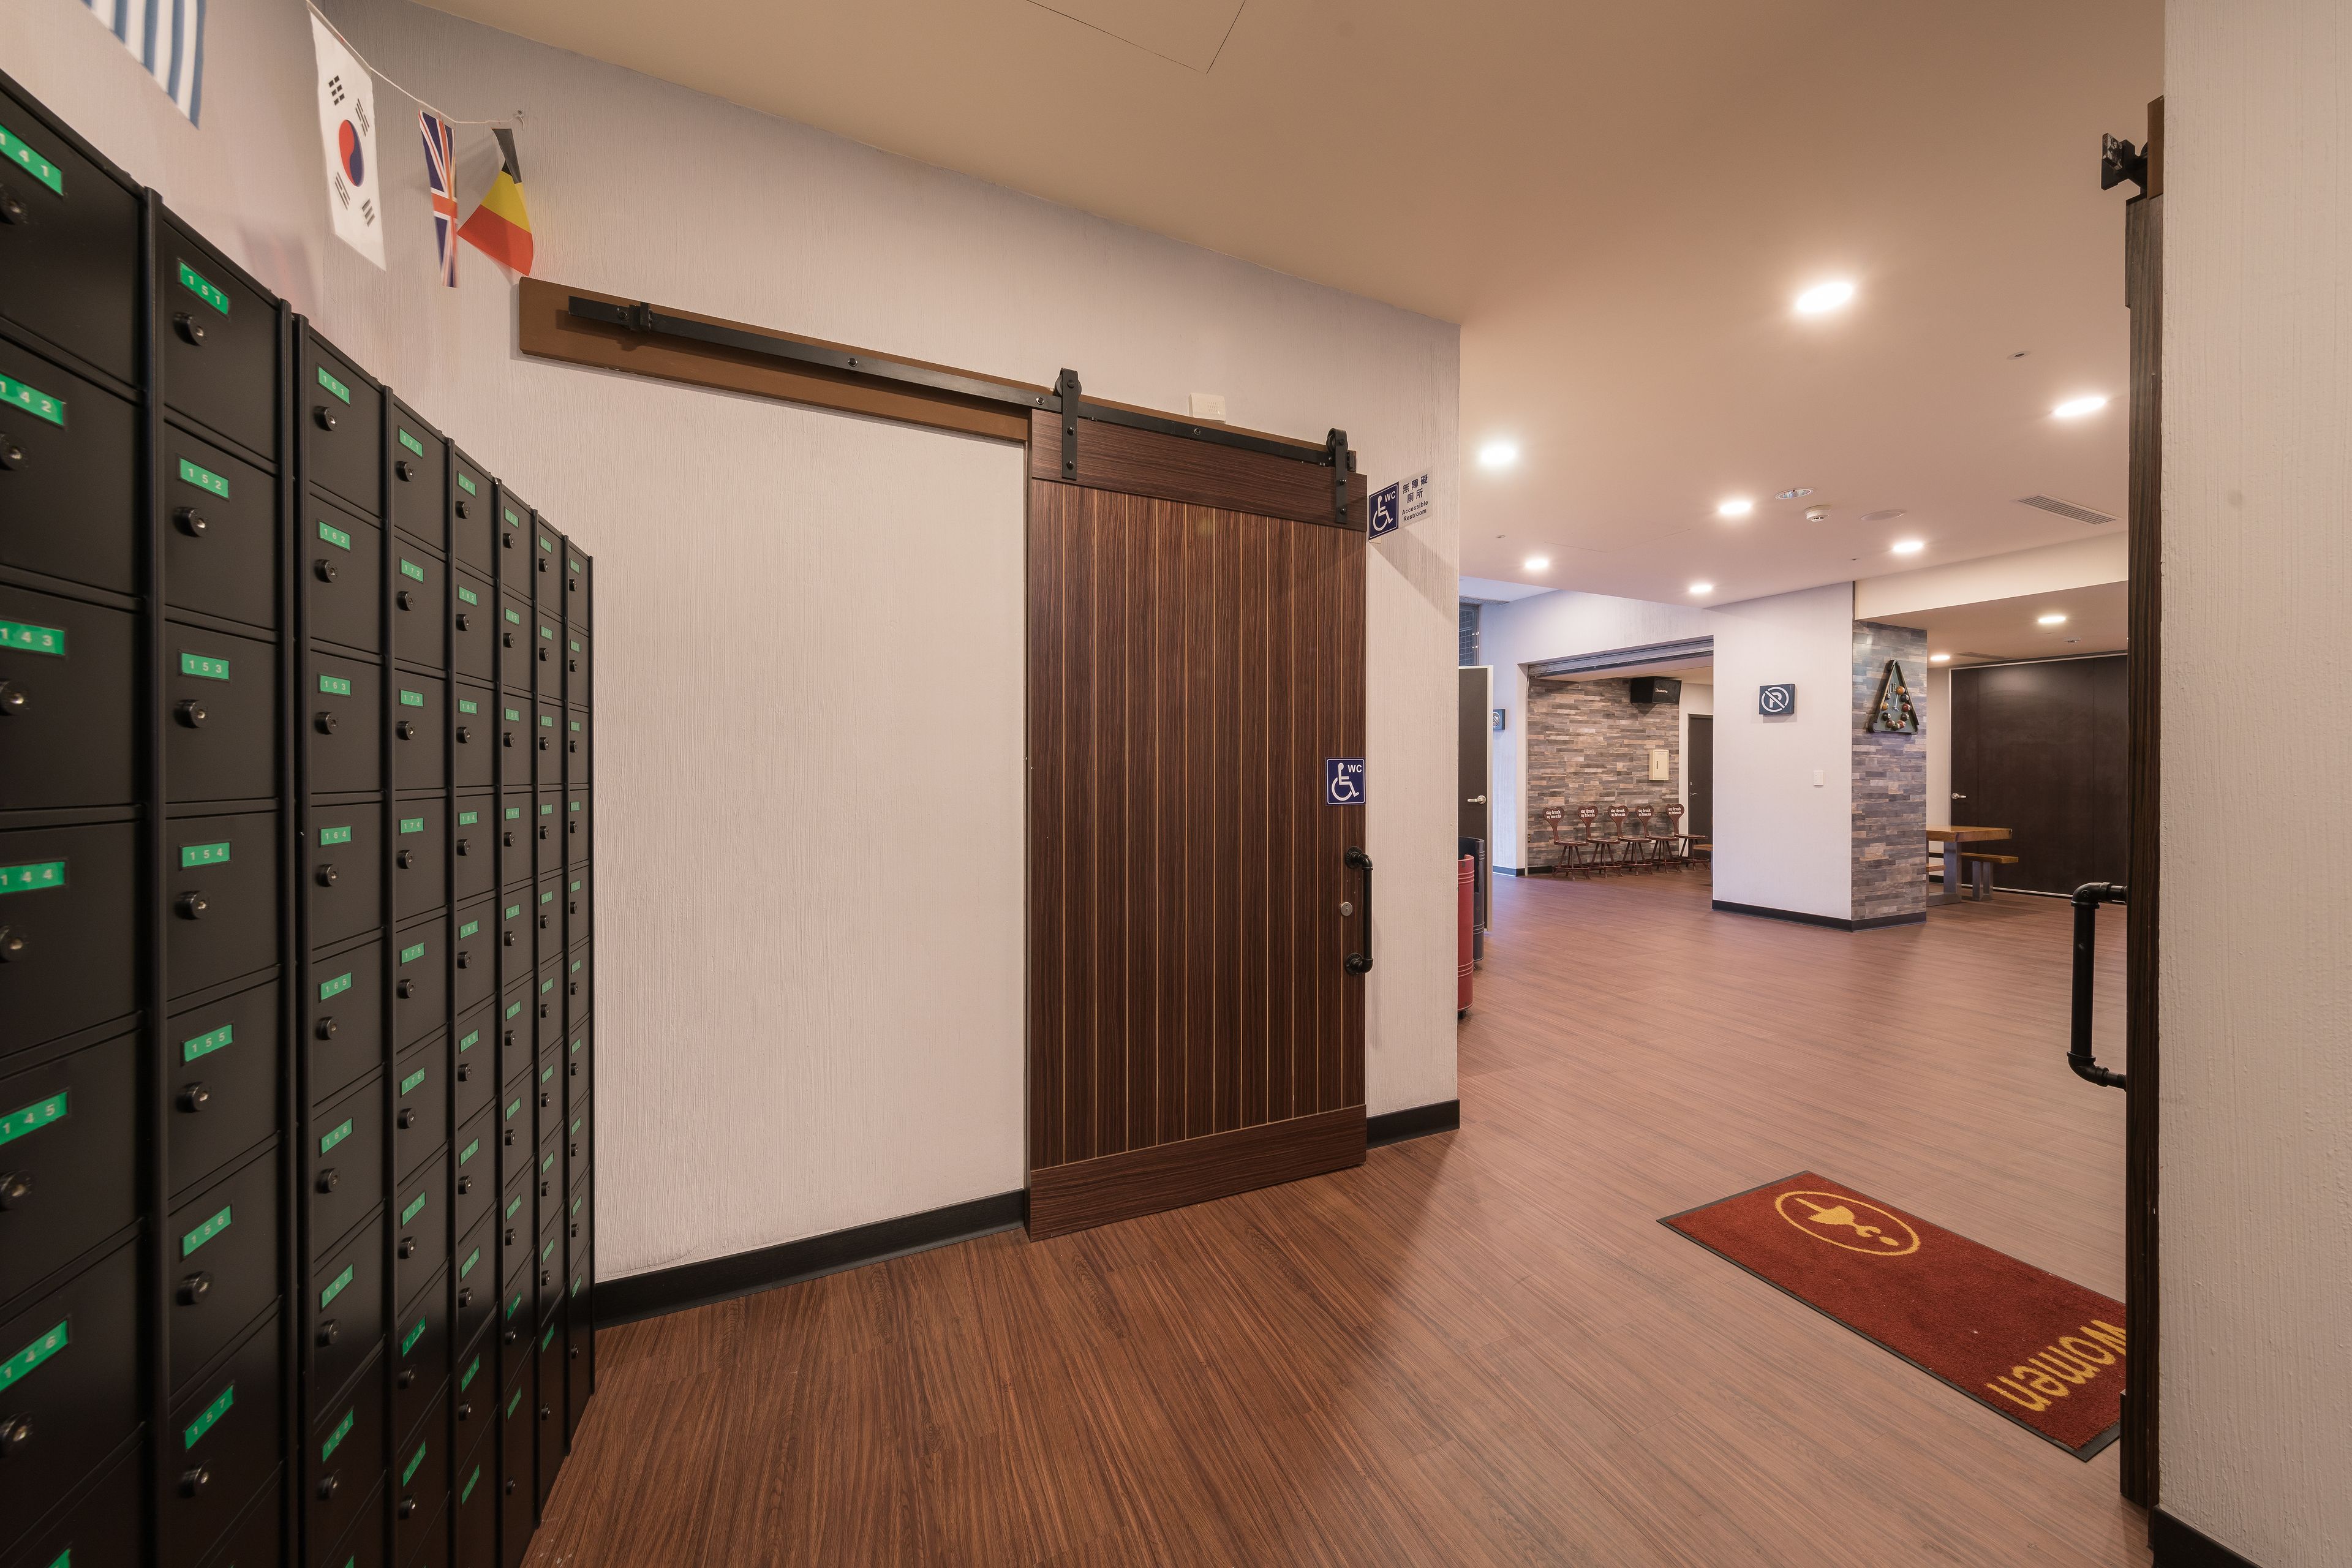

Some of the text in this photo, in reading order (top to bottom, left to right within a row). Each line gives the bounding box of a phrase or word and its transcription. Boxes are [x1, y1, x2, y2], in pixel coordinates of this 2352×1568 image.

[188, 275, 221, 304] 151
[323, 375, 344, 395] 161
[0, 381, 52, 413] 142
[403, 435, 418, 450] 171
[188, 468, 222, 490] 152
[1403, 474, 1428, 494] 無障礙
[1384, 491, 1396, 503] WC
[1407, 488, 1423, 503] 廁所
[1402, 500, 1428, 515] Accessible
[1403, 509, 1427, 522] Restroom
[324, 529, 345, 543] 162
[404, 565, 420, 577] 172
[0, 628, 53, 647] 143
[189, 660, 222, 673] 153
[324, 680, 346, 691] 163
[1348, 764, 1362, 773] WC
[325, 831, 347, 839] 164
[190, 848, 224, 860] 154
[1, 869, 53, 885] 144
[405, 947, 421, 958] 175
[325, 978, 347, 992] 165
[192, 1032, 225, 1052] 155
[3, 1103, 55, 1134] 145
[326, 1126, 347, 1145] 166
[192, 1215, 224, 1243] 156
[326, 1273, 348, 1297] 167
[5, 1335, 56, 1378] 146
[193, 1398, 225, 1435] 157
